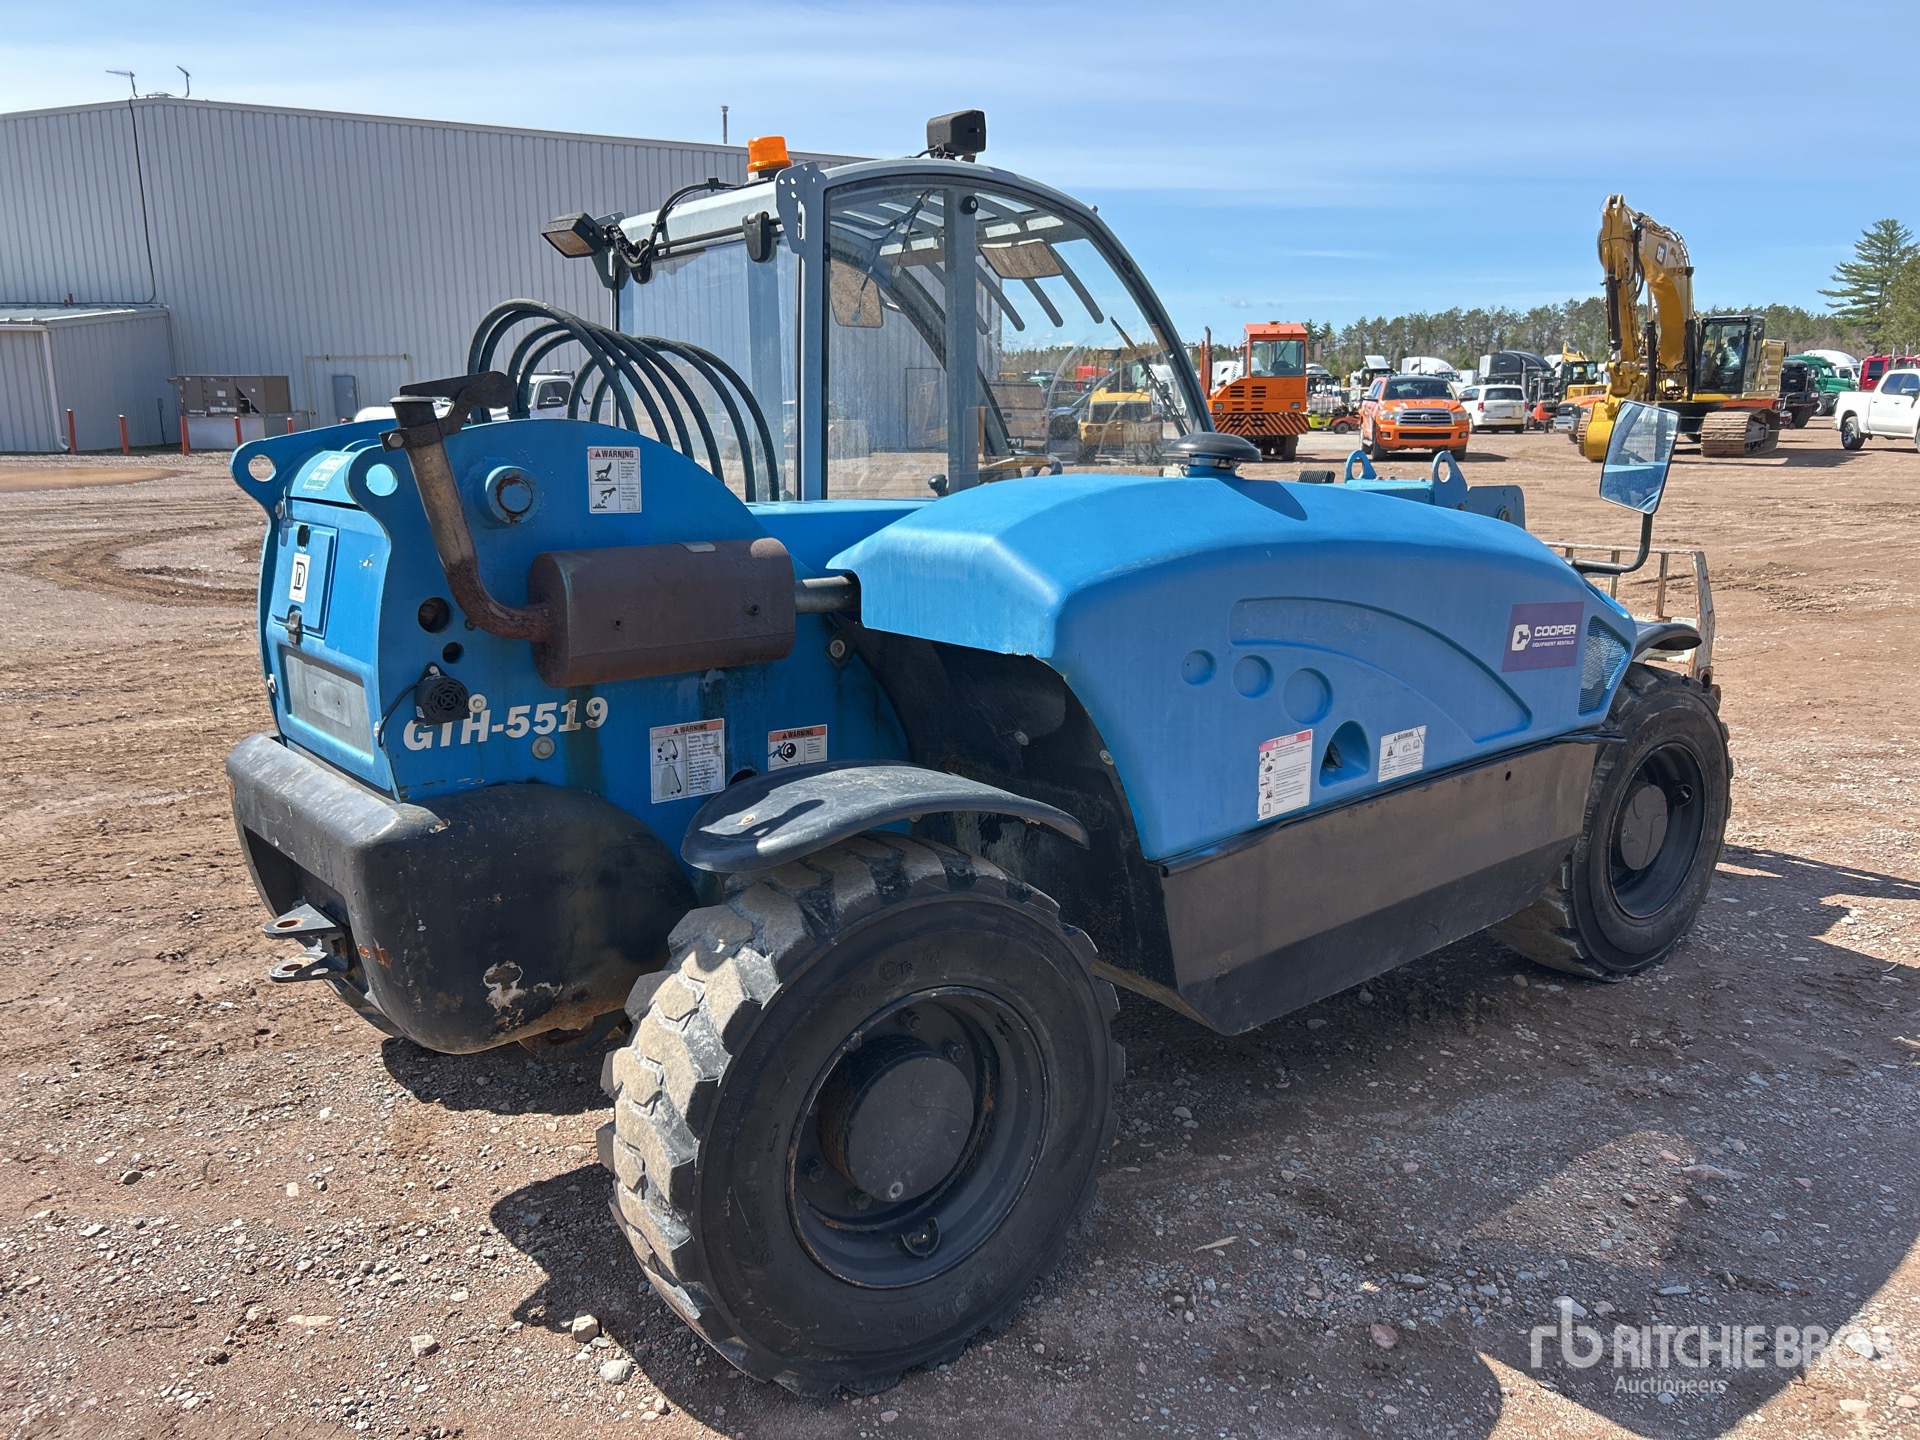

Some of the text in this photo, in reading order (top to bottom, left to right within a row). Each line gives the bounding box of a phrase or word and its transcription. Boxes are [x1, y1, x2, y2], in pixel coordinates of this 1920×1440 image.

[601, 450, 634, 459] WARNING
[1534, 624, 1577, 637] COOPER
[680, 724, 708, 734] WARNING
[787, 728, 814, 739] WARNING
